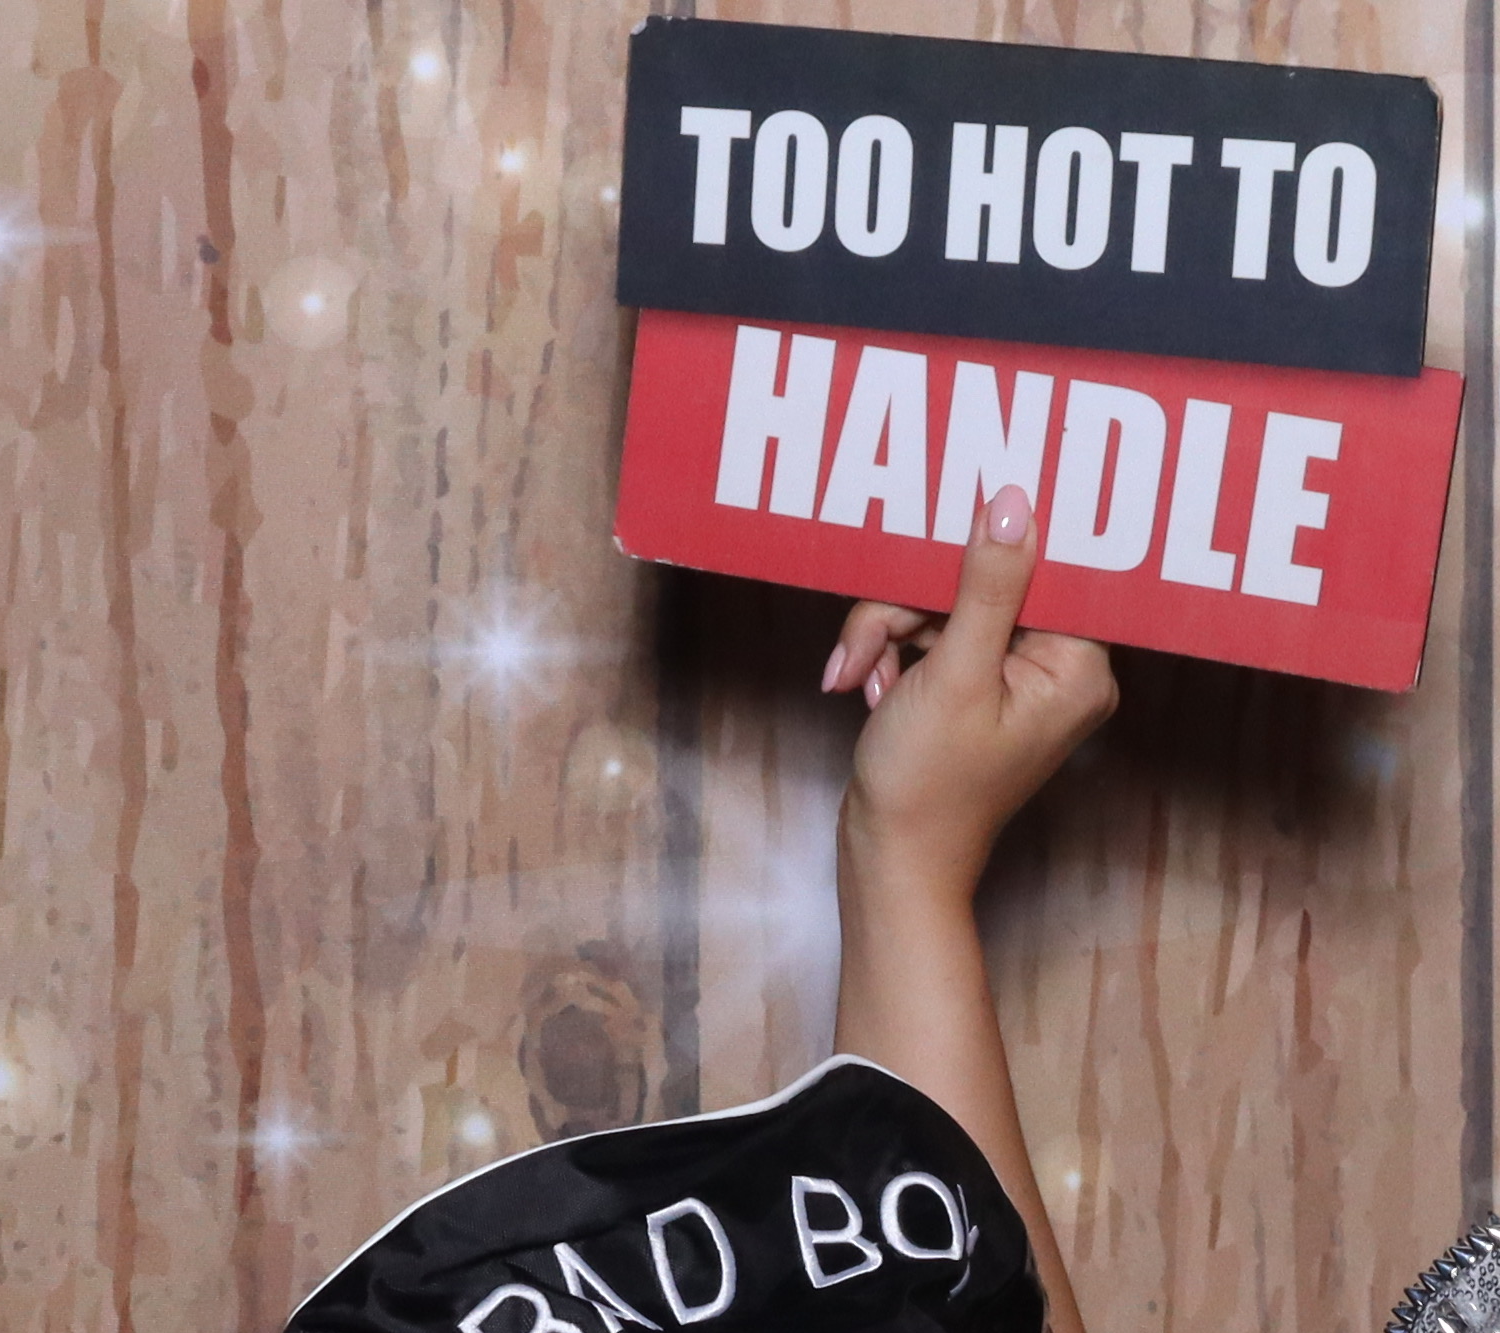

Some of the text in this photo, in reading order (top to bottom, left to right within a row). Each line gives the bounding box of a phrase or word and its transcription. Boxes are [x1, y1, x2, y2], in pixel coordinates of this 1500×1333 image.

[680, 107, 1377, 288] TOO HOT TO
[714, 325, 1343, 606] HANDLE
[790, 1171, 980, 1300] BO
